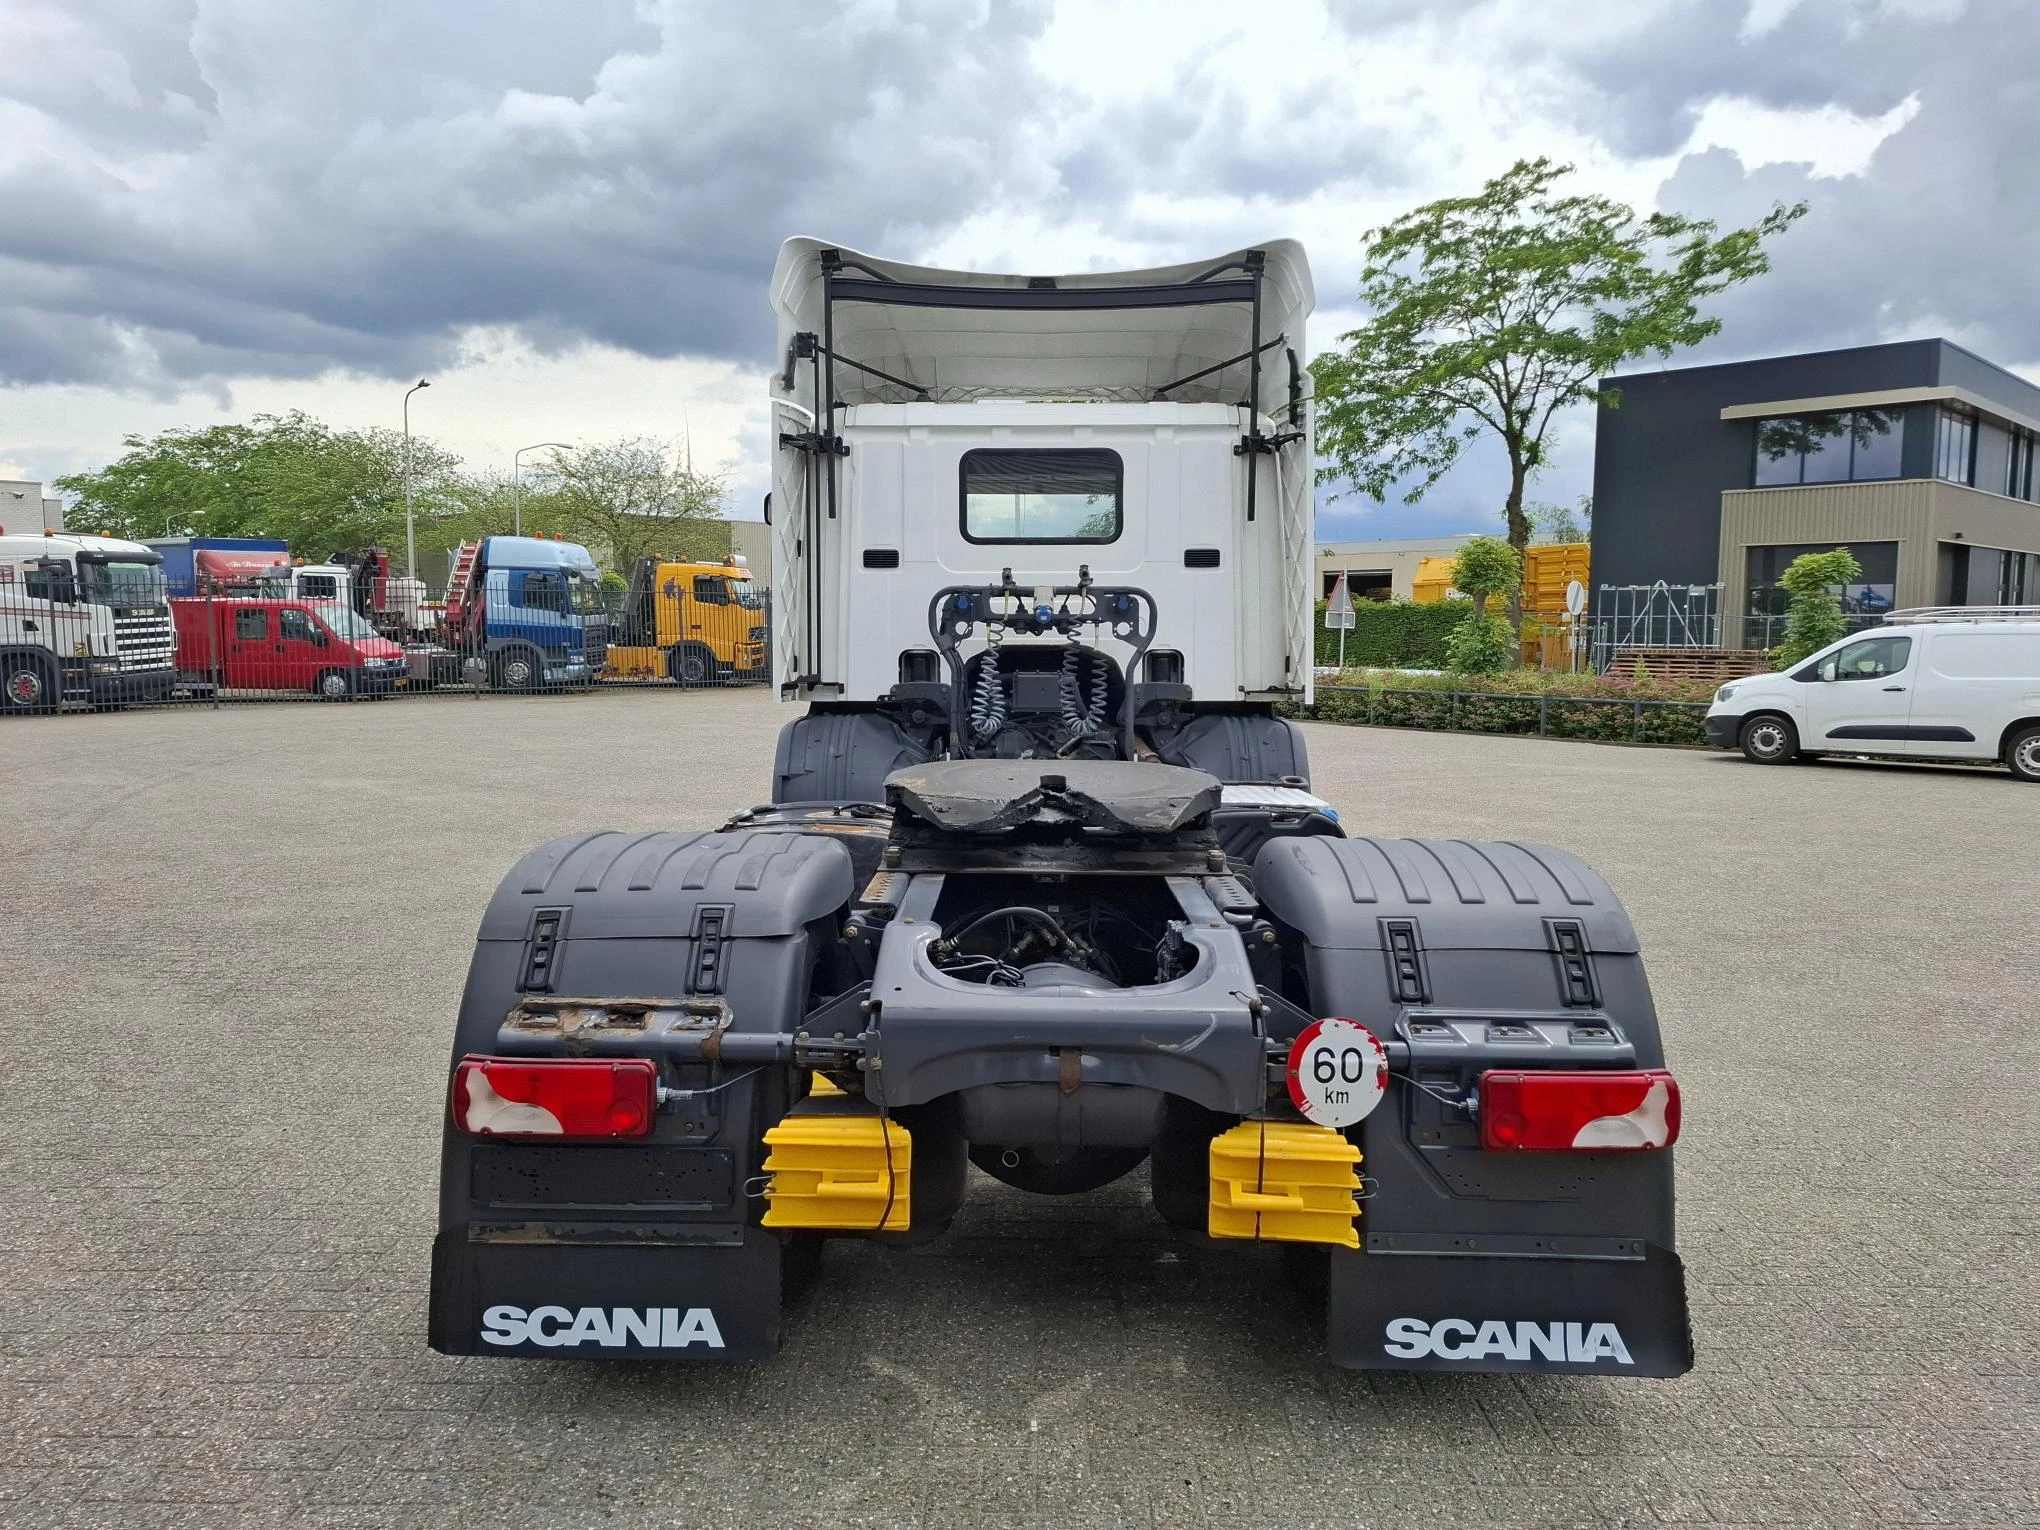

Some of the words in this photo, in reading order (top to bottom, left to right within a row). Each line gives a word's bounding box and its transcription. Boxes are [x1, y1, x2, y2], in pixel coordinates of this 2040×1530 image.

[1313, 1047, 1364, 1084] 60
[1324, 1087, 1350, 1104] km
[481, 1305, 725, 1349] SCANIA
[1384, 1317, 1635, 1365] SCANIA
